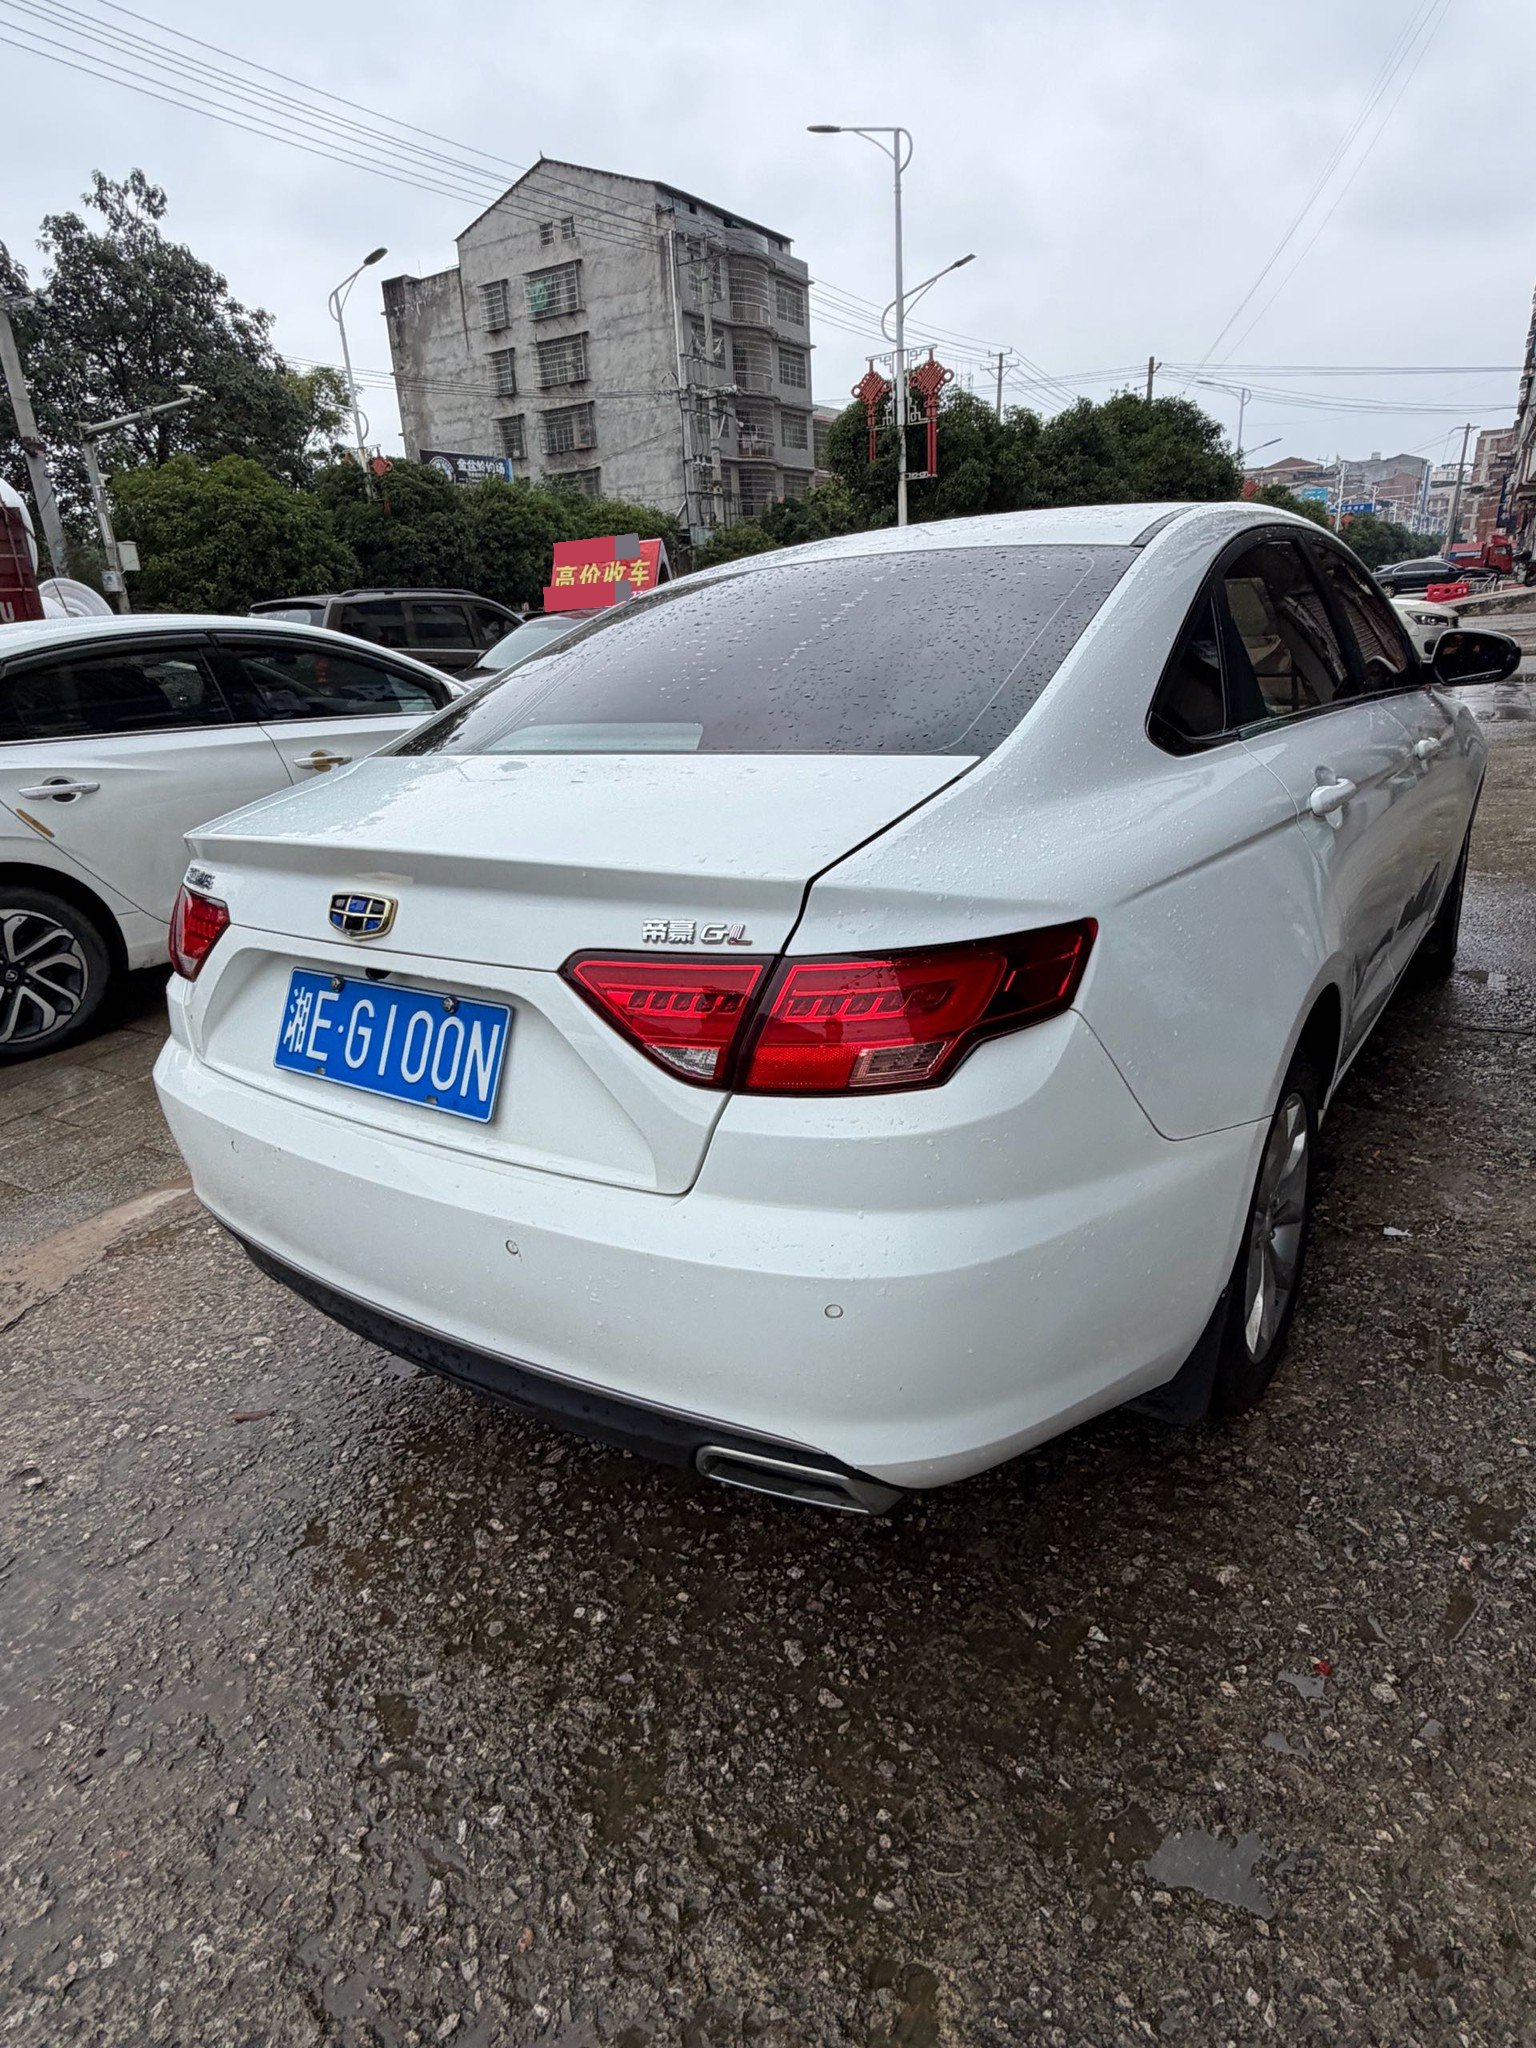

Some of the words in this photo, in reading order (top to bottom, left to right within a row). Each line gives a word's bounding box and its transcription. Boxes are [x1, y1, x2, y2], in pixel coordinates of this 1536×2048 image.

[555, 559, 650, 586] 高价收车
[642, 919, 696, 944] 帝豪
[700, 923, 753, 946] GL
[283, 986, 501, 1102] 湘E·G100N
